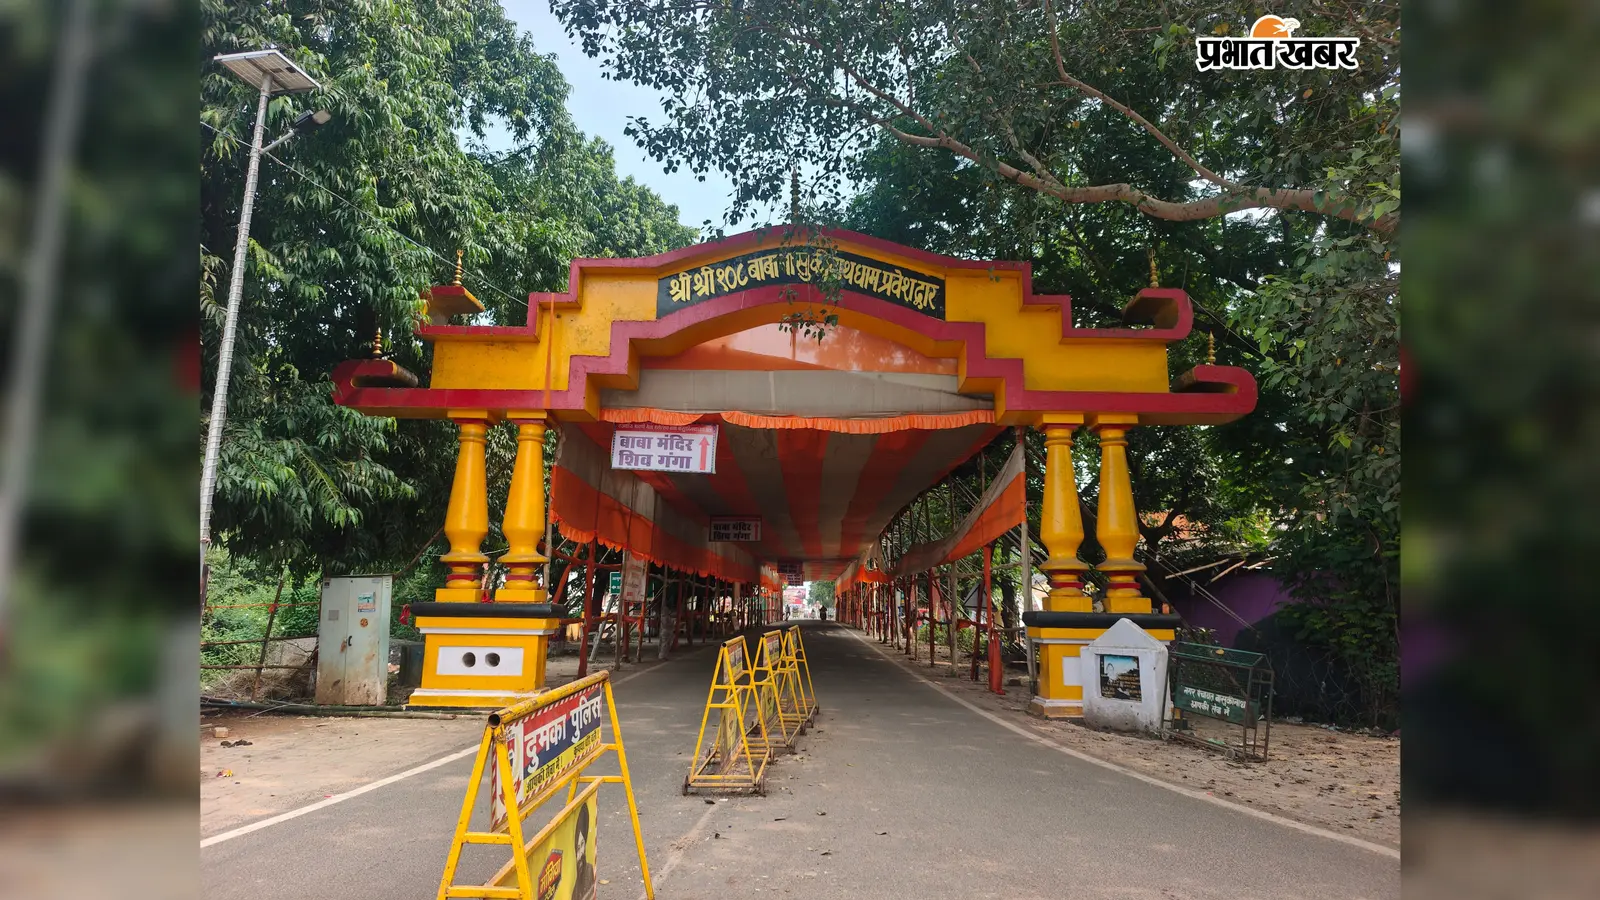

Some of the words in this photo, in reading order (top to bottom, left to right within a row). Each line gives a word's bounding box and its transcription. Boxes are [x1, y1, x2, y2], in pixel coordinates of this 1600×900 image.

[669, 271, 692, 302] श्री
[693, 266, 715, 297] श्री
[716, 262, 748, 293] १०८
[748, 254, 779, 281] बाबा
[619, 435, 654, 450] बाबा
[657, 434, 694, 452] मंदिर
[618, 449, 653, 467] शिव
[657, 452, 693, 469] गंगा
[524, 714, 567, 773] दुमका
[569, 696, 601, 744] पुलिस
[526, 768, 545, 793] आपकी
